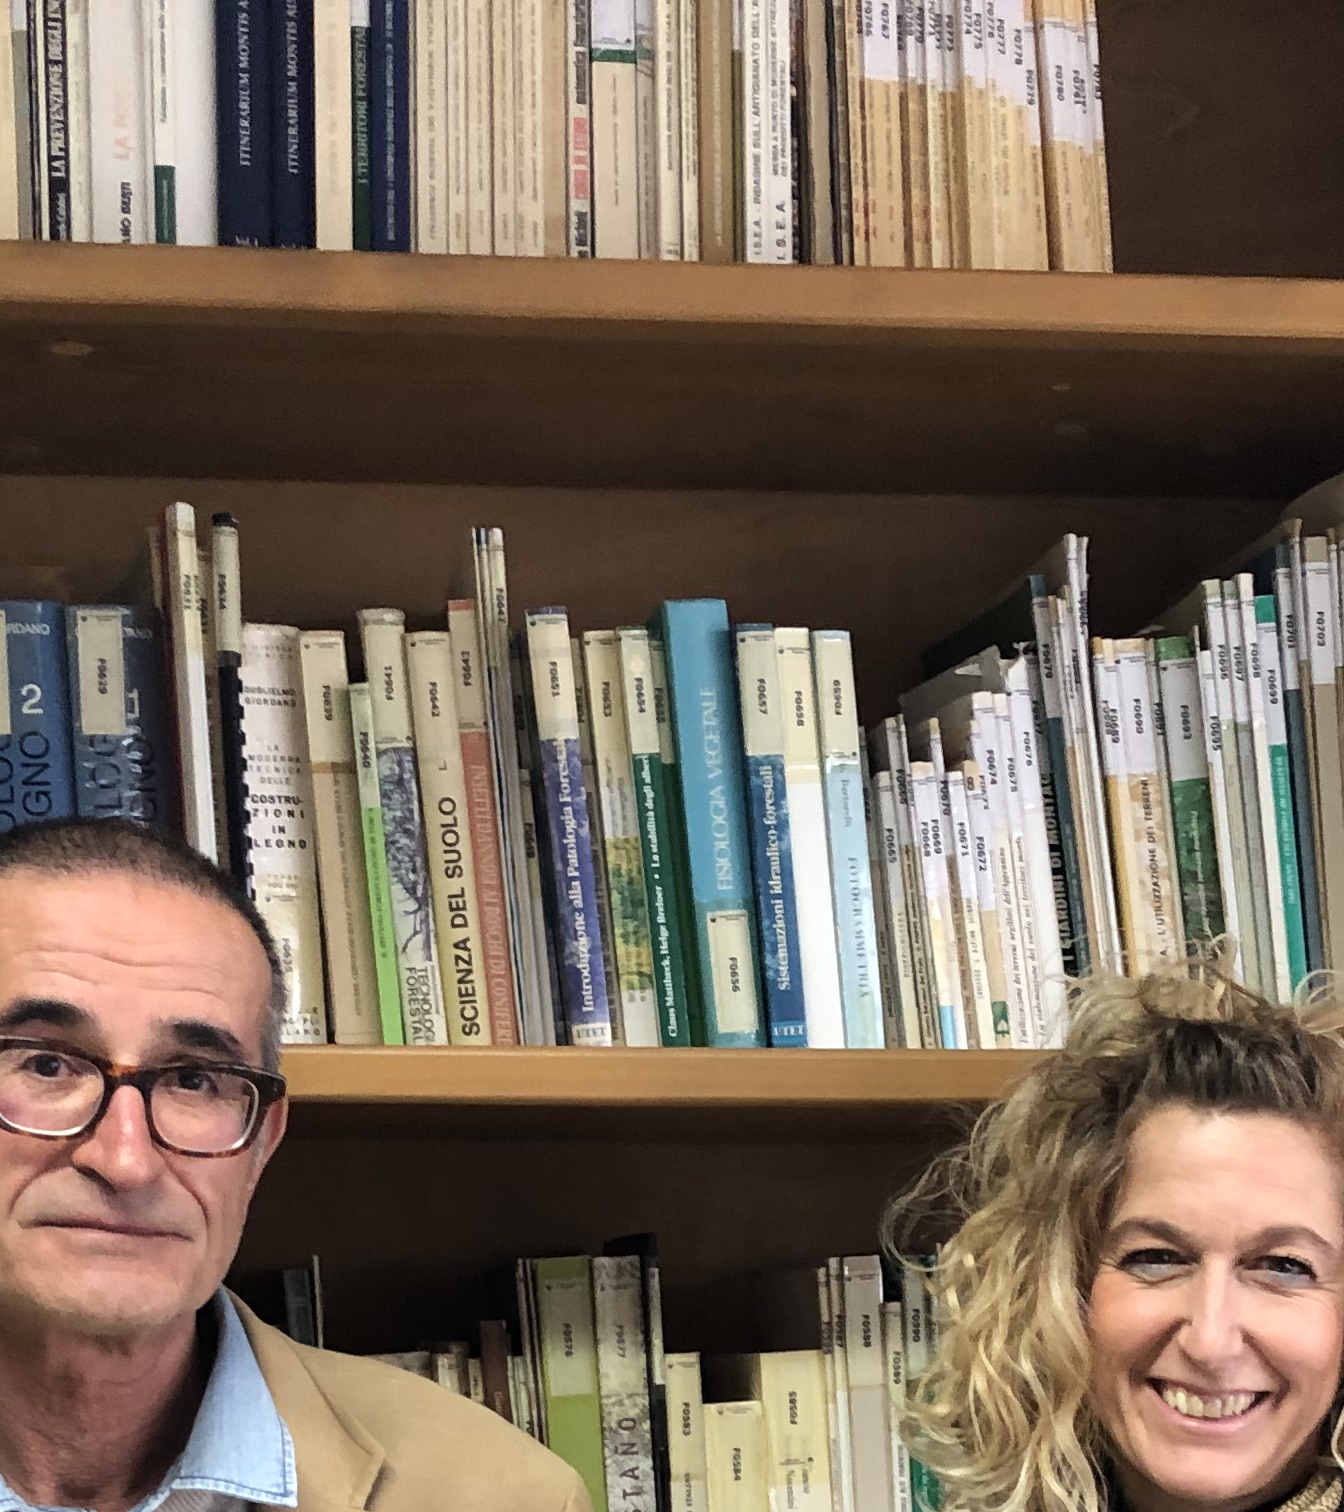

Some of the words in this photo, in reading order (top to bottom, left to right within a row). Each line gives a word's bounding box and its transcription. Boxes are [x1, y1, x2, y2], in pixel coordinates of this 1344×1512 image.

[238, 73, 252, 167] ITINERARIUM
[287, 81, 300, 175] ITINERARIUM
[21, 683, 44, 715] 2
[428, 681, 441, 718] F0642
[757, 678, 768, 715] F0657
[699, 688, 723, 779] VEGETALE
[1023, 731, 1033, 767] F0676
[987, 749, 999, 785] F0674
[272, 824, 287, 835] IN
[437, 796, 464, 879] SUOLO
[562, 804, 580, 878] Patologia
[709, 785, 734, 892] FISIOLOGIA
[759, 764, 784, 895] idraulico-forestali
[976, 836, 988, 872] F0672
[447, 887, 470, 930] DEL
[567, 881, 584, 909] alla
[574, 911, 595, 1013] Introduzione
[770, 899, 790, 991] Sistemazioni
[456, 936, 482, 1038] SCIENZA
[728, 956, 740, 993] F0656
